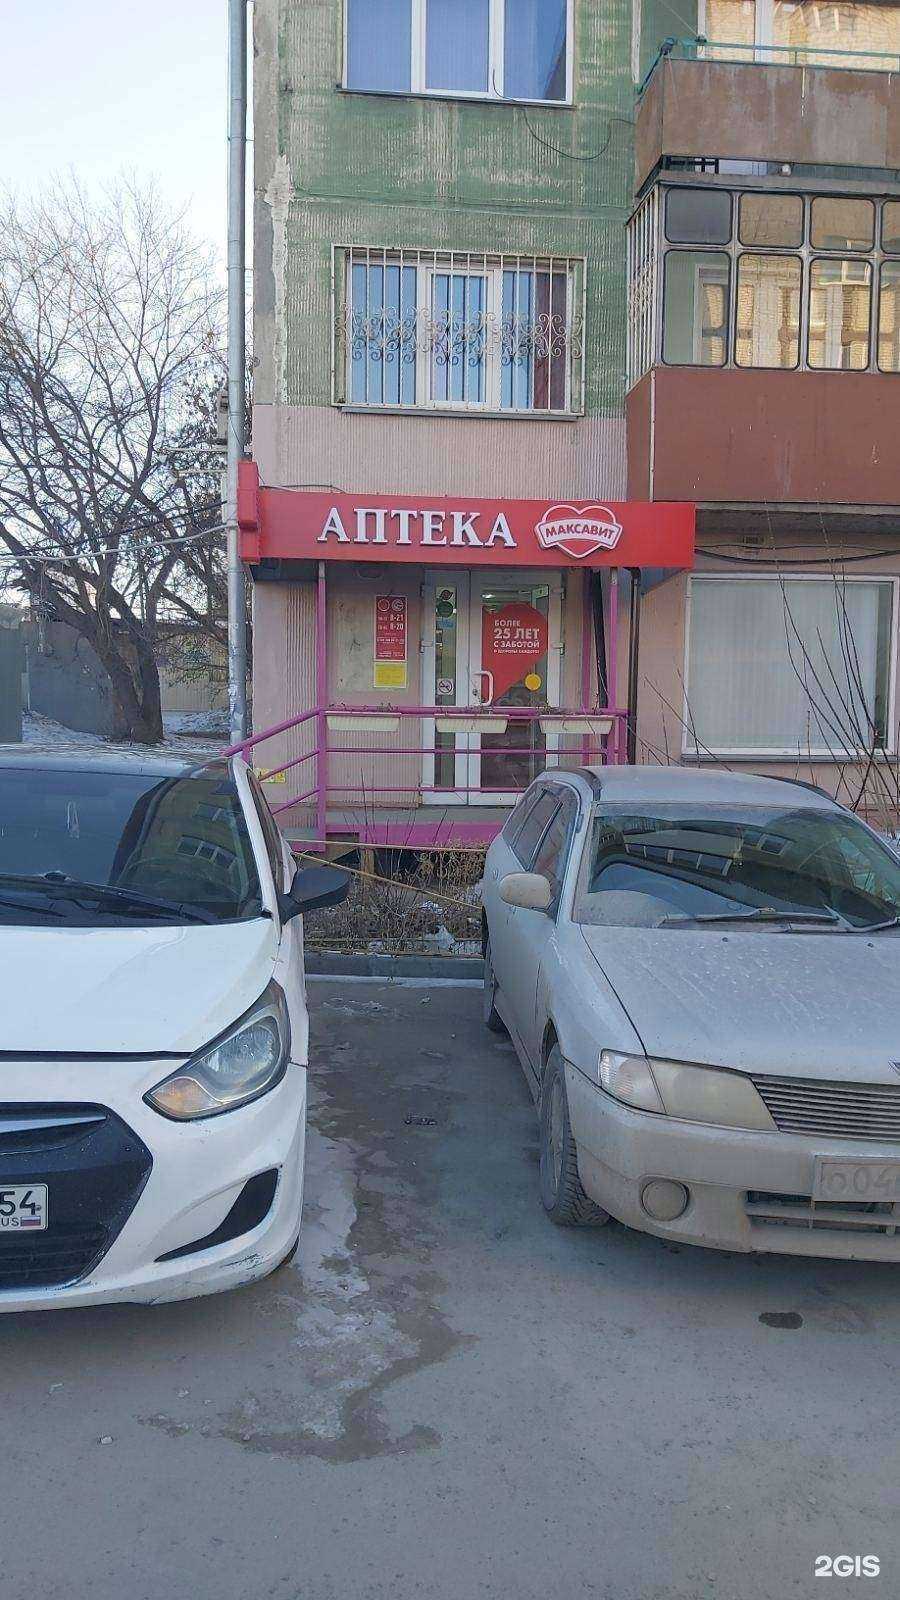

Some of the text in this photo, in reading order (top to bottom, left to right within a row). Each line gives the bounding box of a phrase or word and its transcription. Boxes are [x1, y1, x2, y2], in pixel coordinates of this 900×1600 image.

[316, 507, 518, 548] АПТЕКА
[545, 523, 615, 539] МАКСАВИТ
[494, 619, 521, 627] БОЛЕЕ
[493, 627, 540, 639] 25 ЛЕТ
[493, 639, 540, 648] С ЗАБОТОЙ
[0, 1190, 36, 1216] 54
